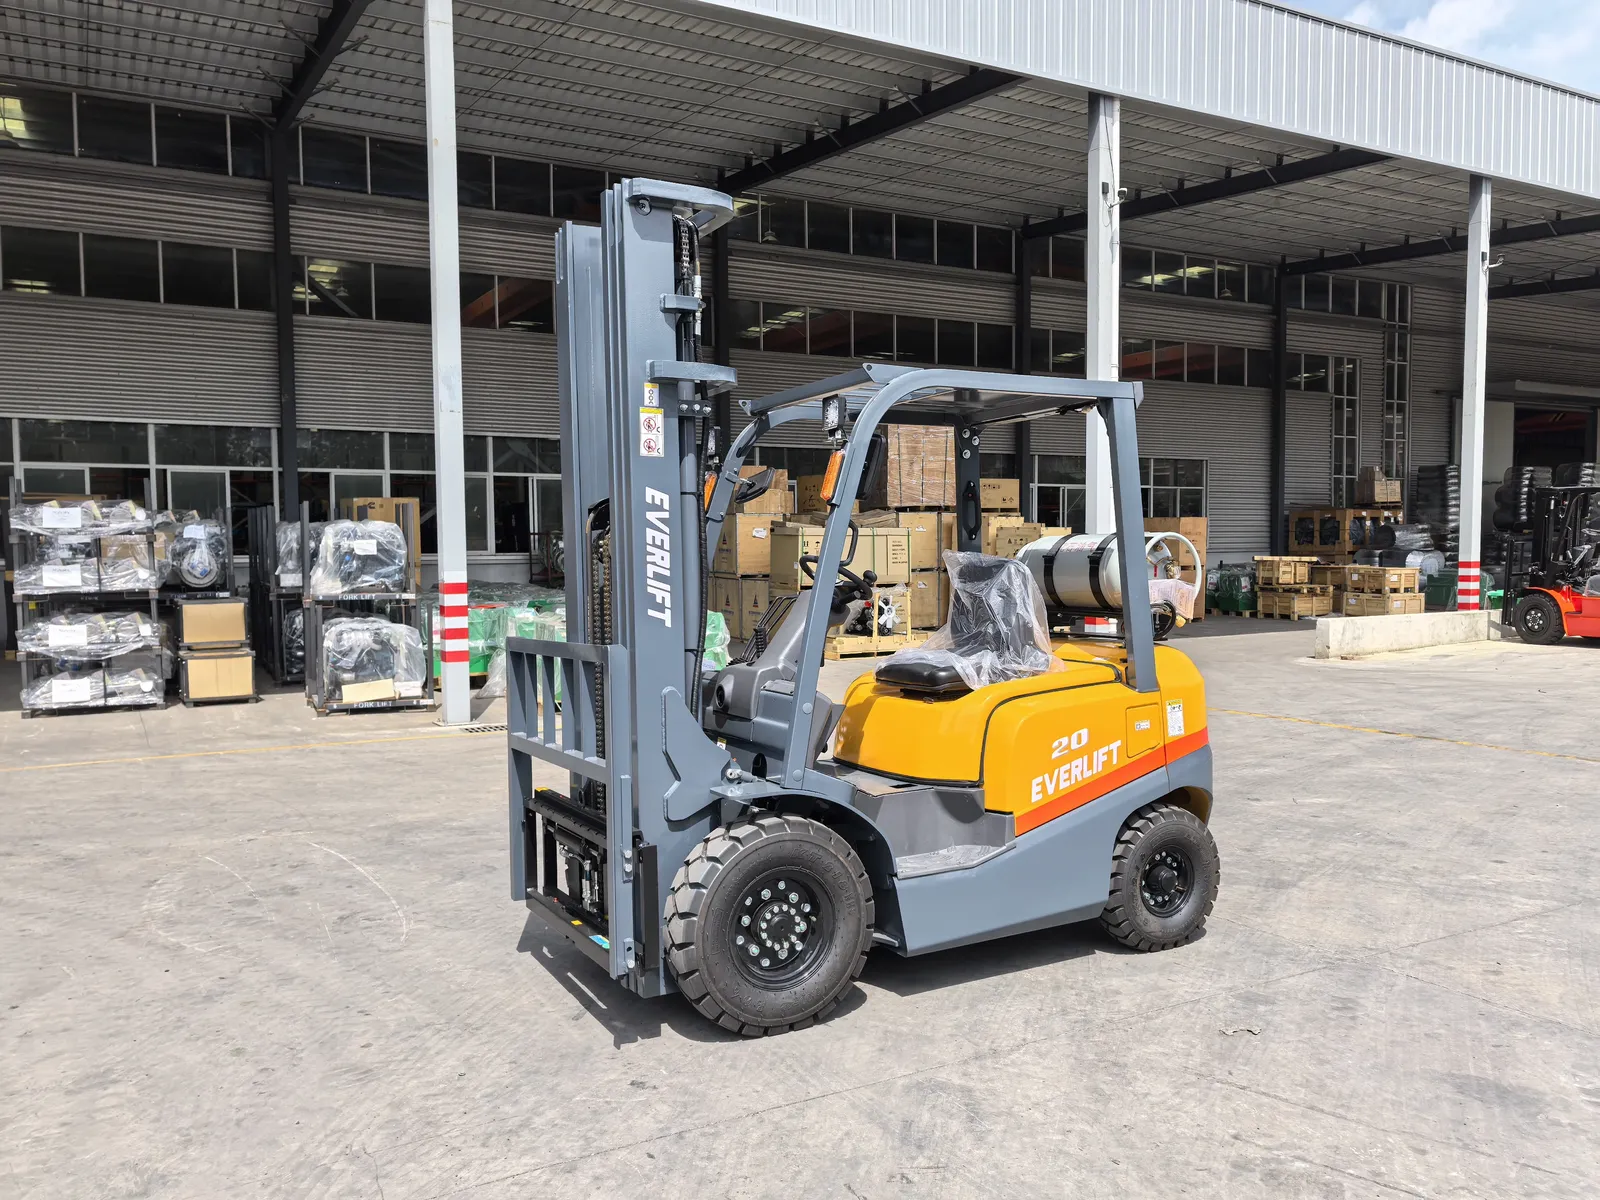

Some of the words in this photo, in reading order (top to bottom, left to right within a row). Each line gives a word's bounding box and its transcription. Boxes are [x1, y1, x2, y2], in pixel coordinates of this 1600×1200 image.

[645, 486, 672, 628] EVERLIFT
[1031, 739, 1122, 803] EVERLIFT
[1051, 727, 1089, 760] 20
